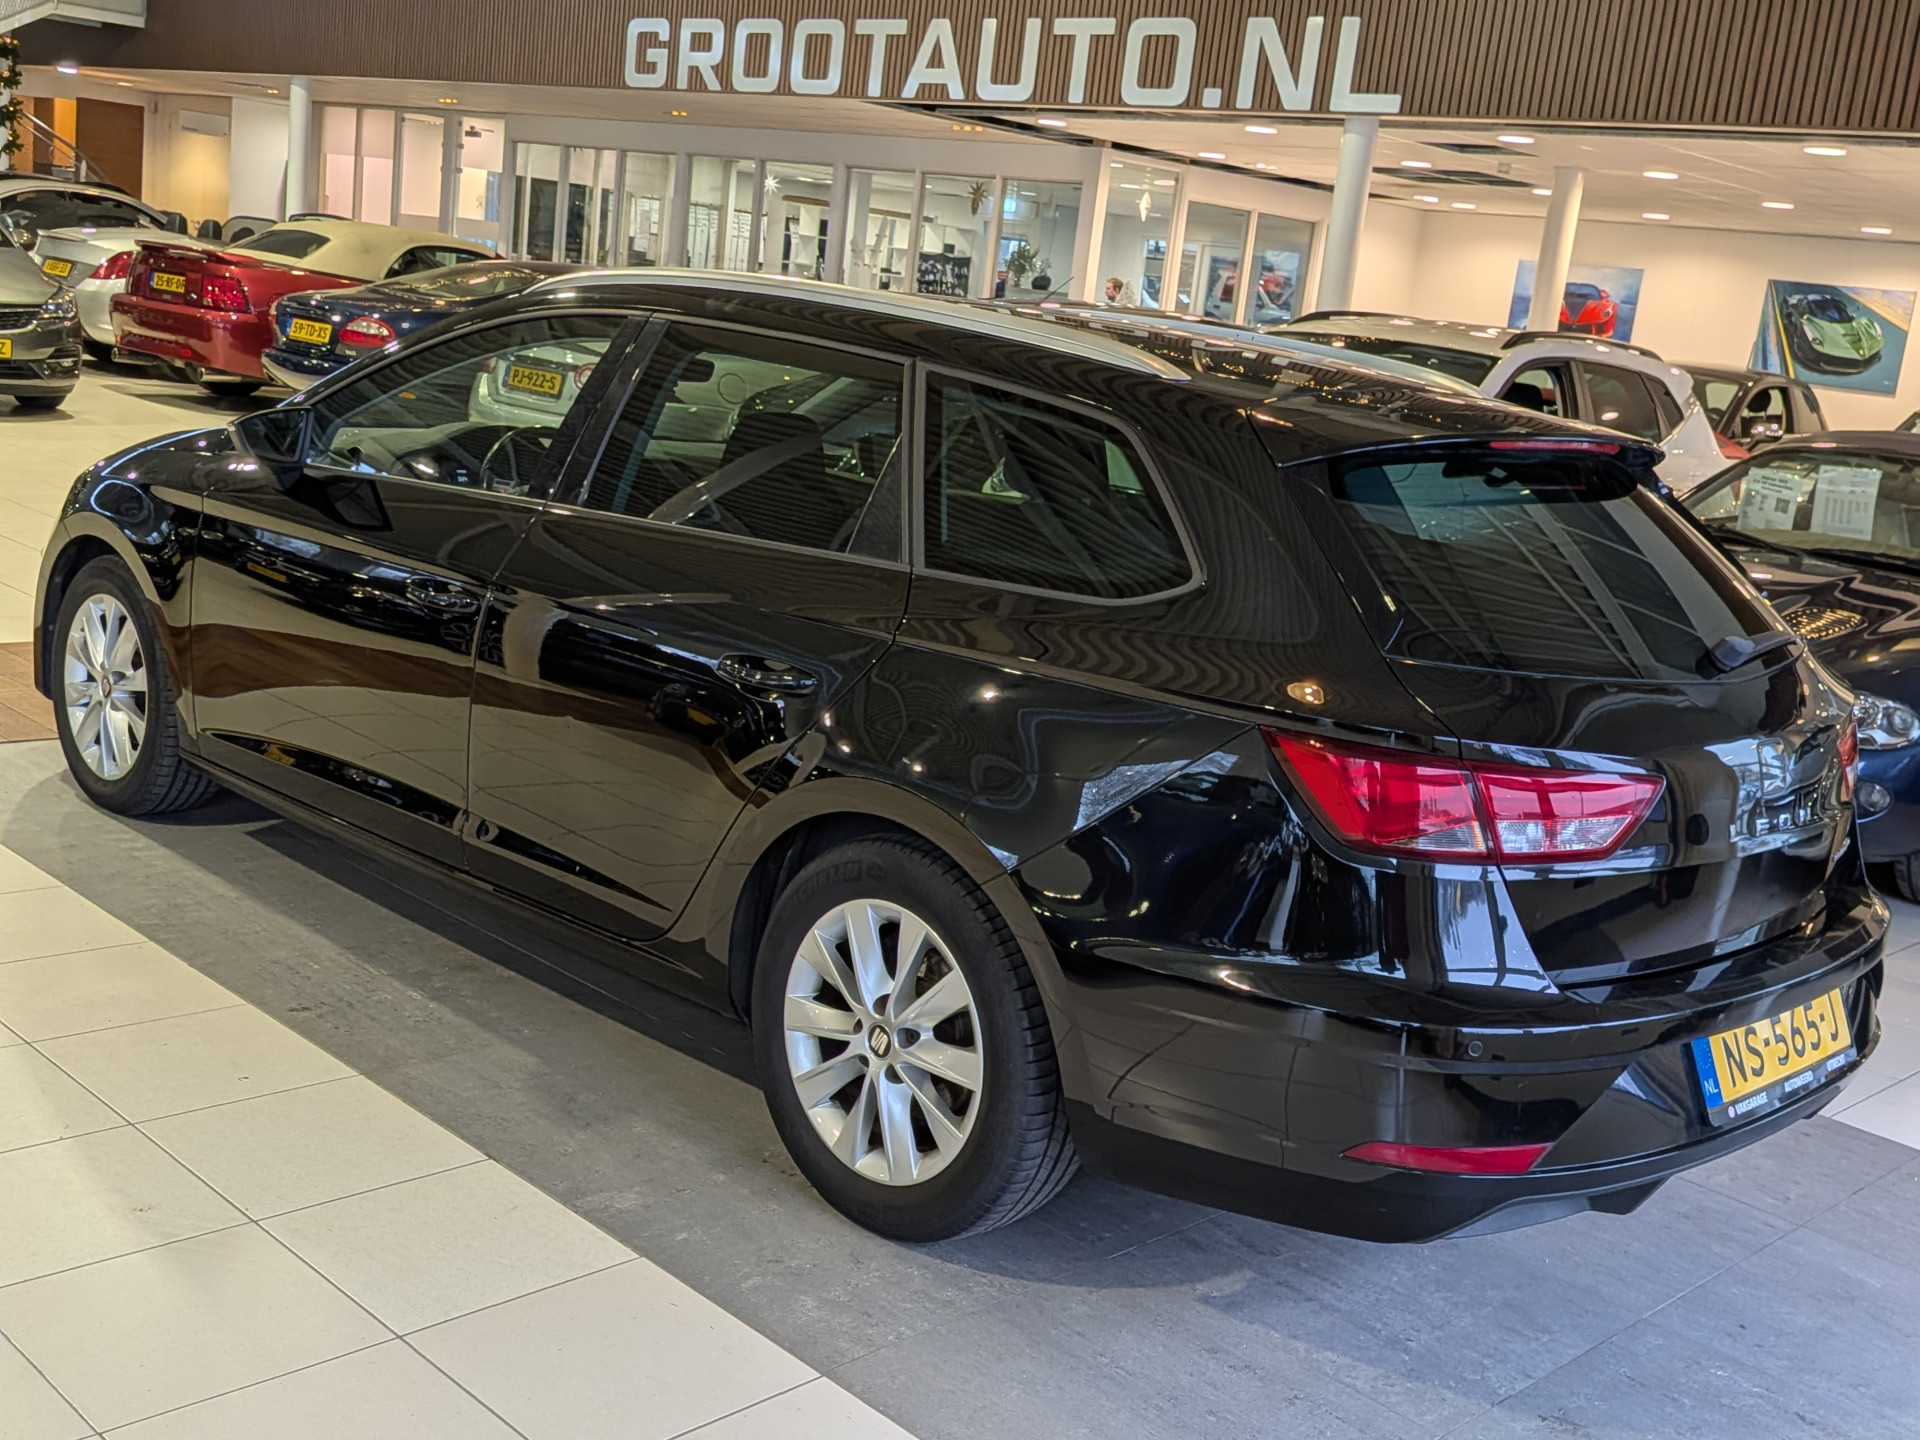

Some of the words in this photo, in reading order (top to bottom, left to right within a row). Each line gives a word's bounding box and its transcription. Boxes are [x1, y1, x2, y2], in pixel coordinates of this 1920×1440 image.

[624, 15, 1402, 115] GROOTAUTO.NL
[292, 321, 329, 341] 59-TD-XS
[512, 369, 557, 390] PJ-922-S
[1721, 993, 1839, 1089] NS-565-J
[1704, 1077, 1719, 1097] NL
